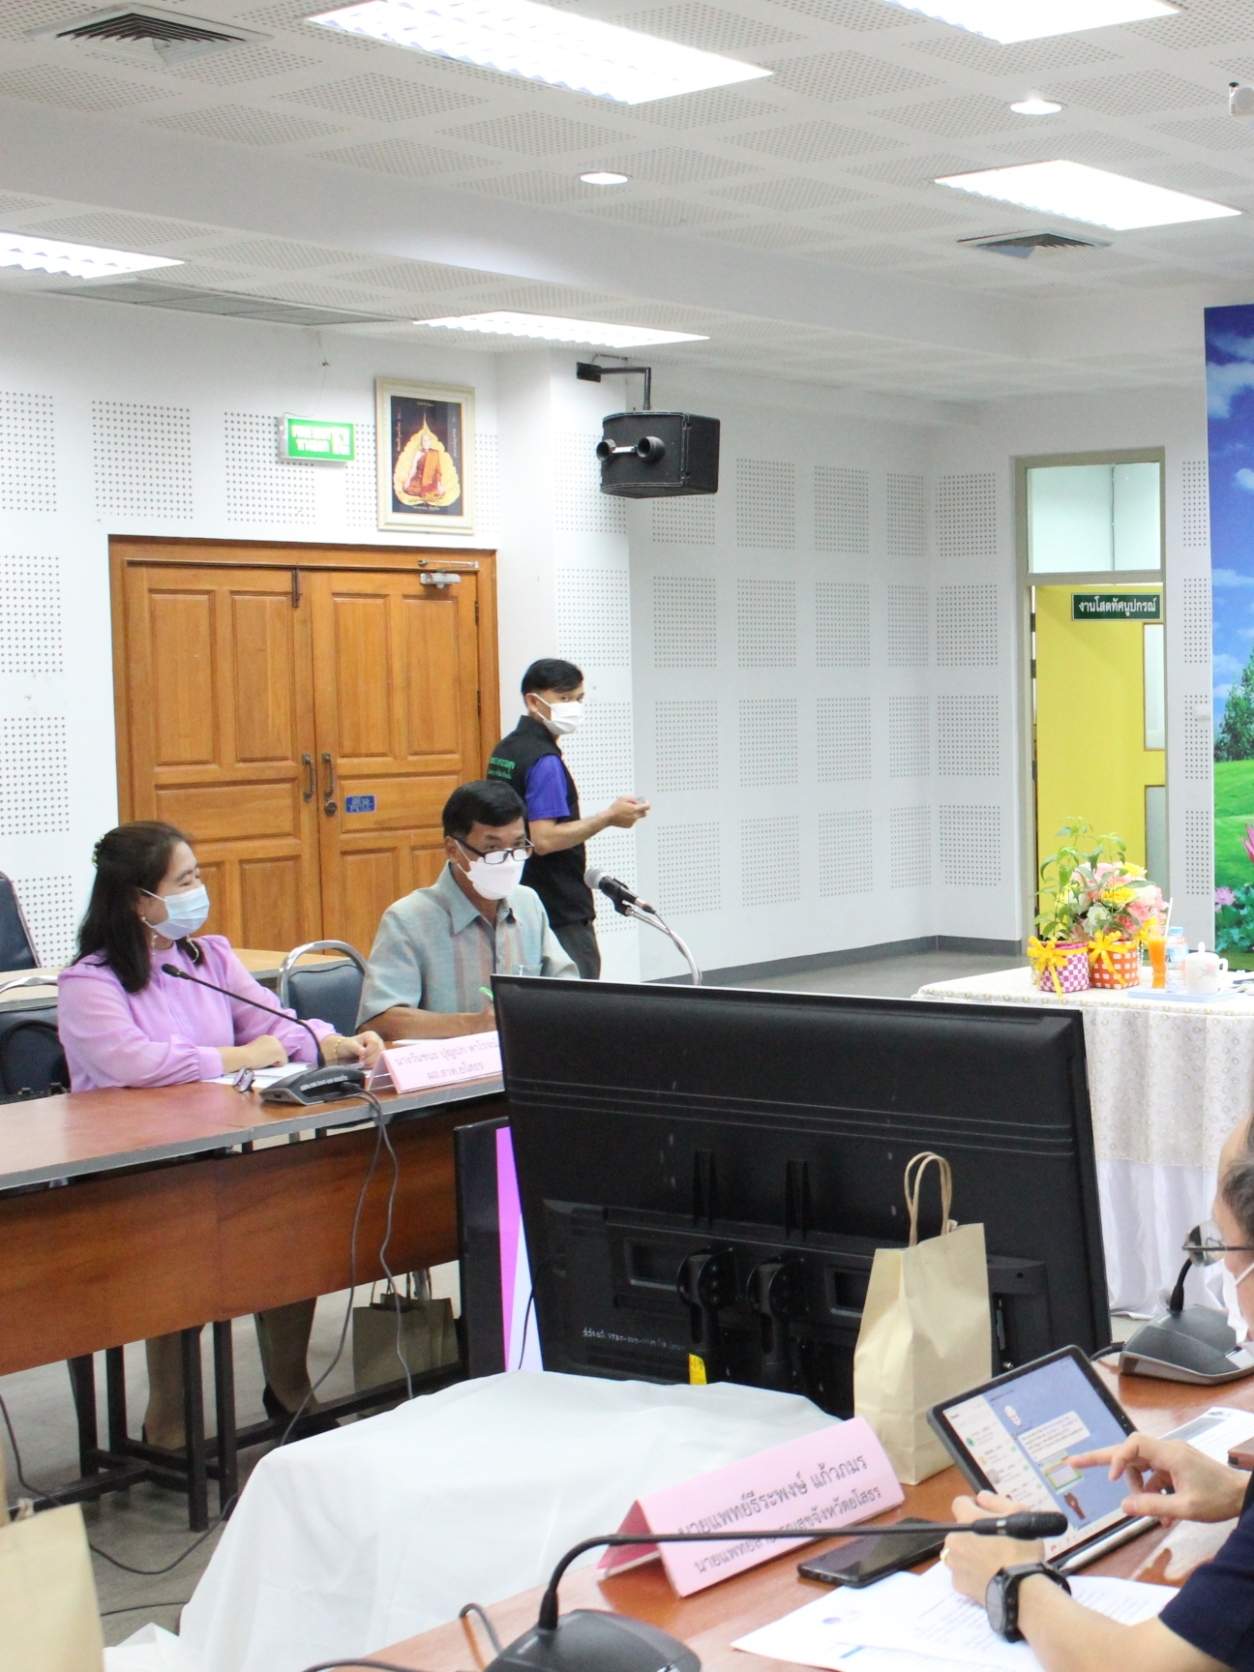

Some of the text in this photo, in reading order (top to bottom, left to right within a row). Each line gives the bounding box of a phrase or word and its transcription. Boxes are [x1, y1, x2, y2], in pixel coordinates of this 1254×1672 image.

[1079, 596, 1157, 616] งานโสตทัศนูปกรณ์
